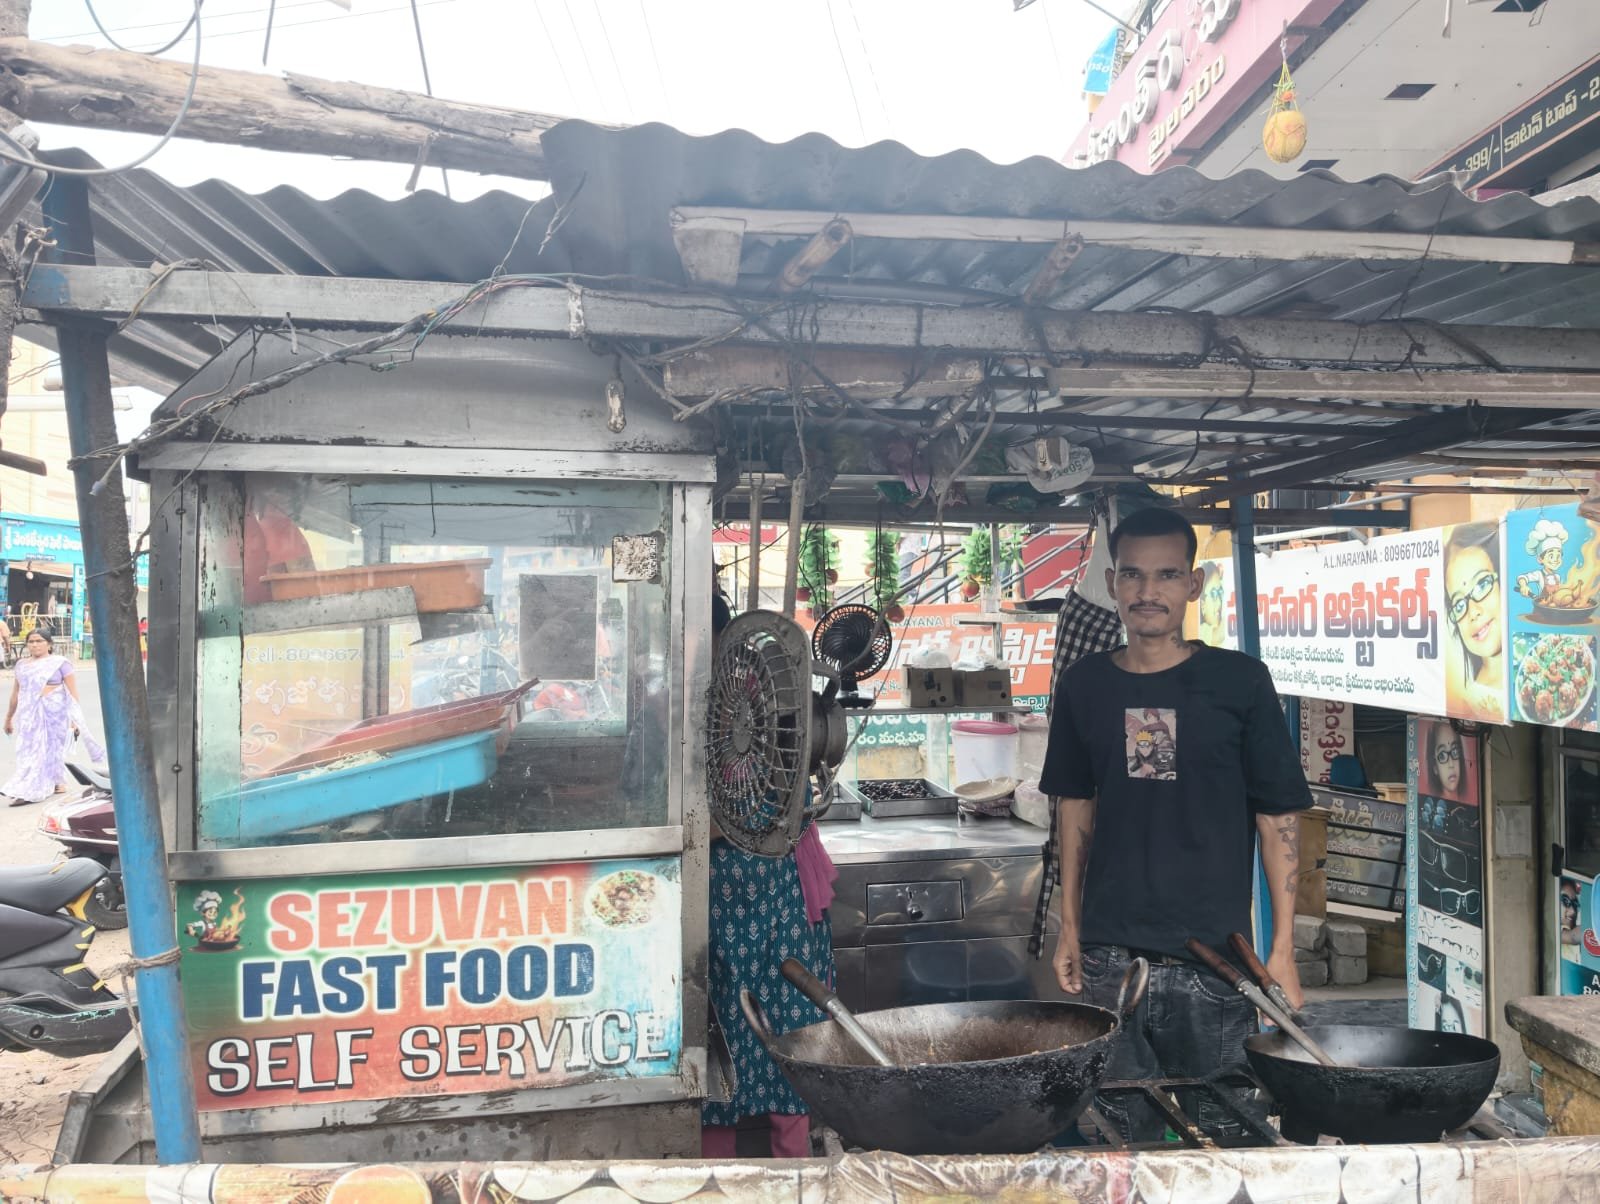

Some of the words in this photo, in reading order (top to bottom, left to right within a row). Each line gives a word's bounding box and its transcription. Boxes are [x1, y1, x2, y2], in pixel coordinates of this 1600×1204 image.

[1504, 110, 1543, 153] కాటన్
[1545, 89, 1578, 128] టాప్
[1323, 548, 1378, 569] A.L.NARAYANA
[1384, 539, 1440, 562] 8096670284
[1323, 567, 1439, 668] ఆప్టికల్స్
[268, 879, 569, 952] SEZUVAN
[240, 954, 406, 1019] FAST
[425, 943, 595, 1008] FOOD
[206, 1026, 375, 1095] SELF
[400, 1009, 670, 1081] SERVICE
